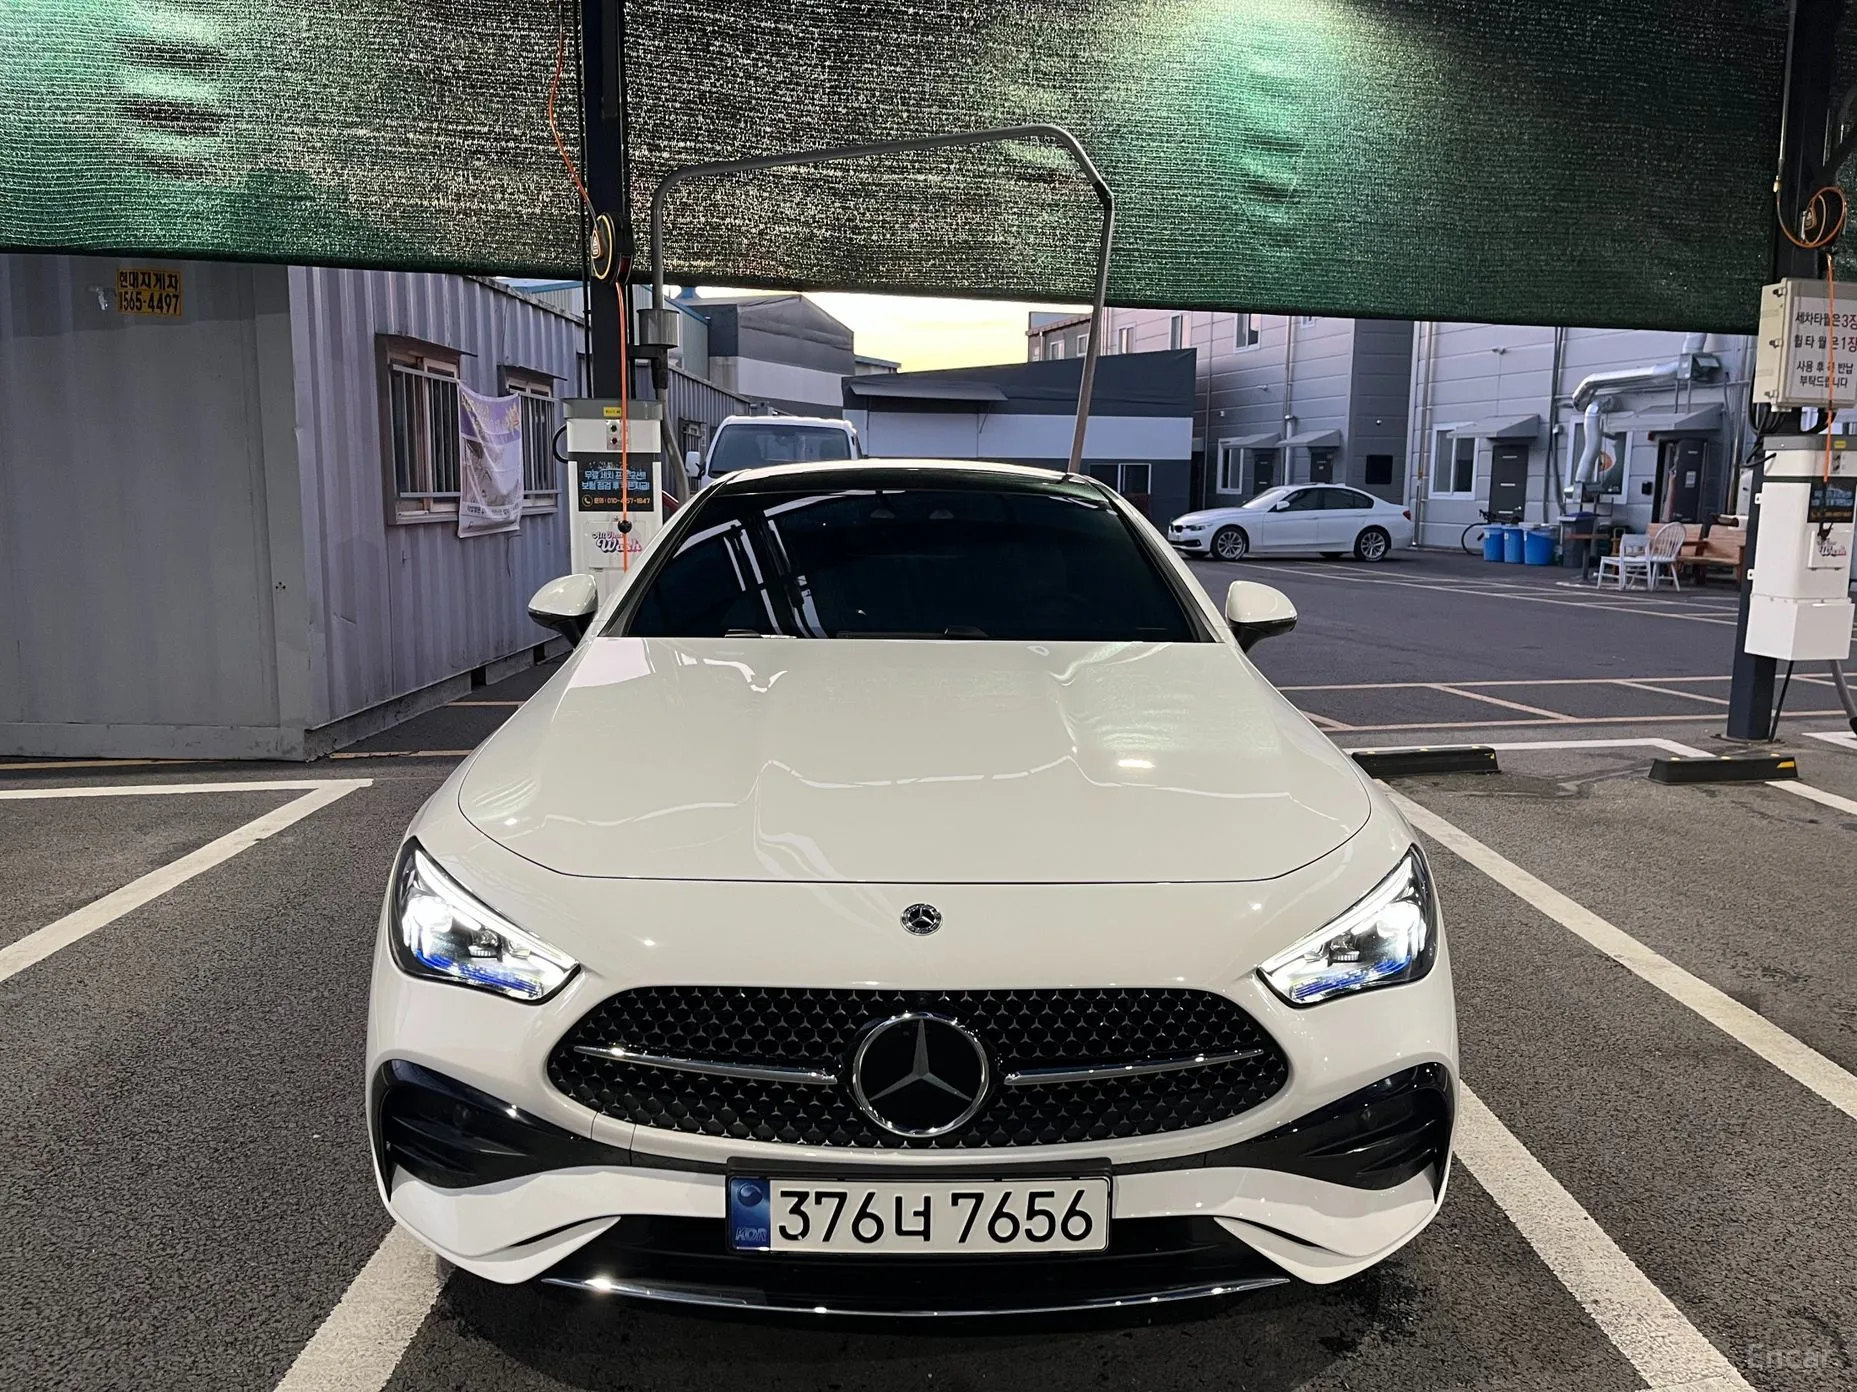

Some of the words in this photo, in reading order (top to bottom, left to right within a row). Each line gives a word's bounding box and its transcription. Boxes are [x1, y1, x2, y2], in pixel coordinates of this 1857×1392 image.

[119, 271, 179, 293] 현대지게차
[119, 291, 180, 314] 1565-4497
[1796, 360, 1813, 373] 사용
[1816, 361, 1824, 373] 후
[1838, 362, 1854, 375] 반납
[778, 1189, 933, 1243] 376너
[950, 1189, 1094, 1244] 7656
[735, 1226, 767, 1241] KOR
